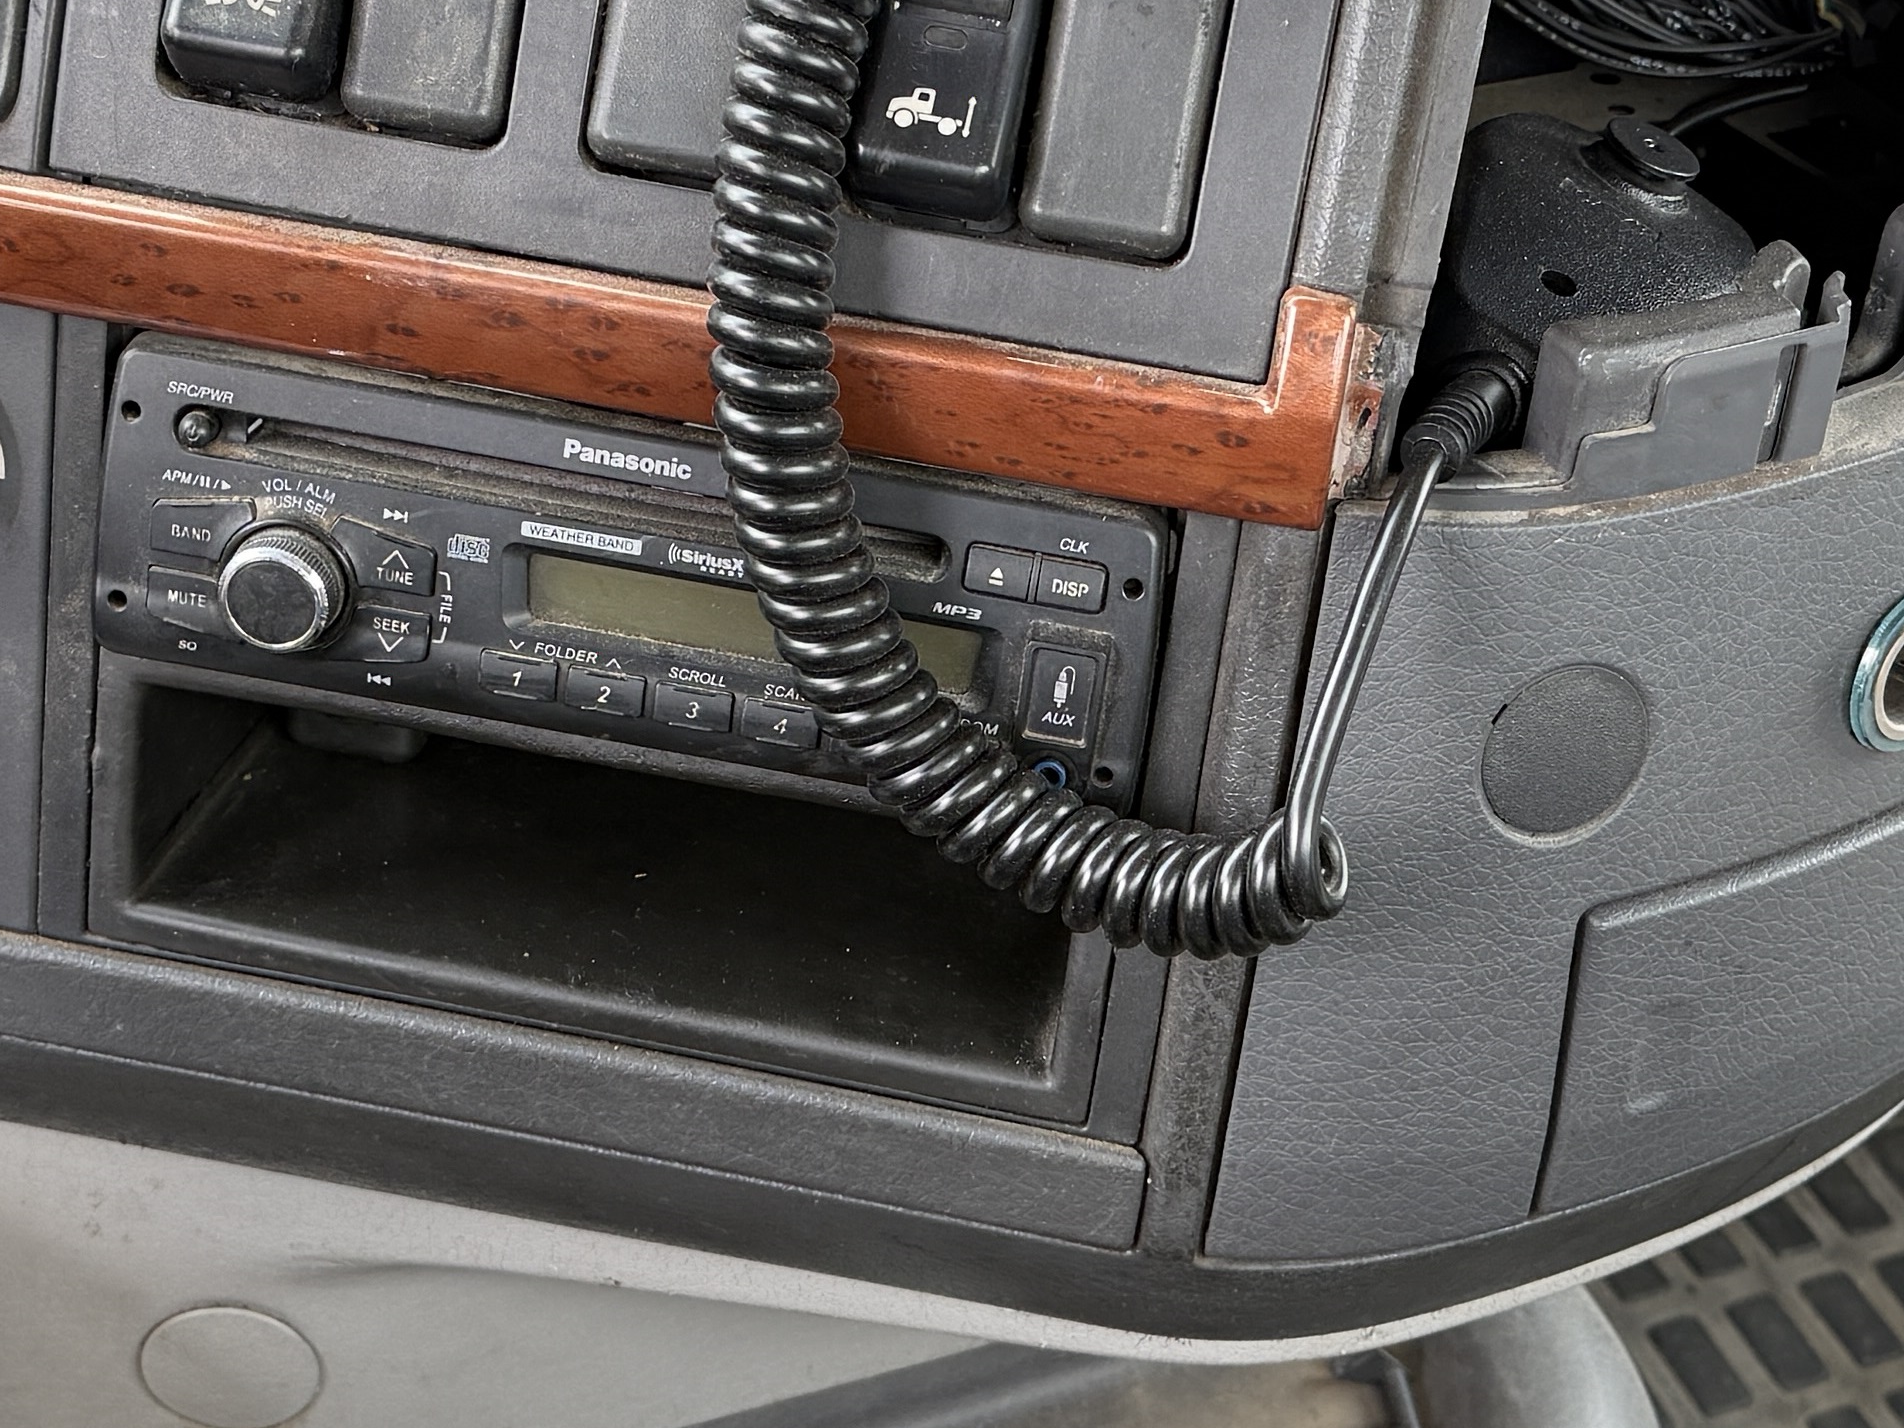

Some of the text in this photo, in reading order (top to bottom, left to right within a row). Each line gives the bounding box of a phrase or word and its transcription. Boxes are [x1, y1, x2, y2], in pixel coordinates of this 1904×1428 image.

[167, 380, 235, 404] SRC/PWR
[562, 437, 693, 480] Panasonic
[261, 478, 292, 493] VOL
[304, 482, 336, 504] ALM
[265, 495, 328, 520] PUSH SEL
[171, 524, 212, 543] BAND
[529, 524, 635, 553] WEATHER BAND
[1059, 537, 1090, 555] CLK
[376, 567, 414, 586] TUNE
[699, 565, 745, 579] READY
[1051, 578, 1090, 598] DISP
[167, 589, 207, 608] MUTE
[439, 594, 453, 624] FILE
[932, 601, 983, 621] MP3
[372, 617, 410, 635] SEEK
[534, 641, 598, 664] FOLDER
[512, 670, 523, 687] 1
[668, 666, 726, 688] SCROLL
[597, 685, 611, 703] 2
[685, 701, 700, 719] 3
[1041, 711, 1076, 727] AUX
[773, 718, 788, 735] 4
